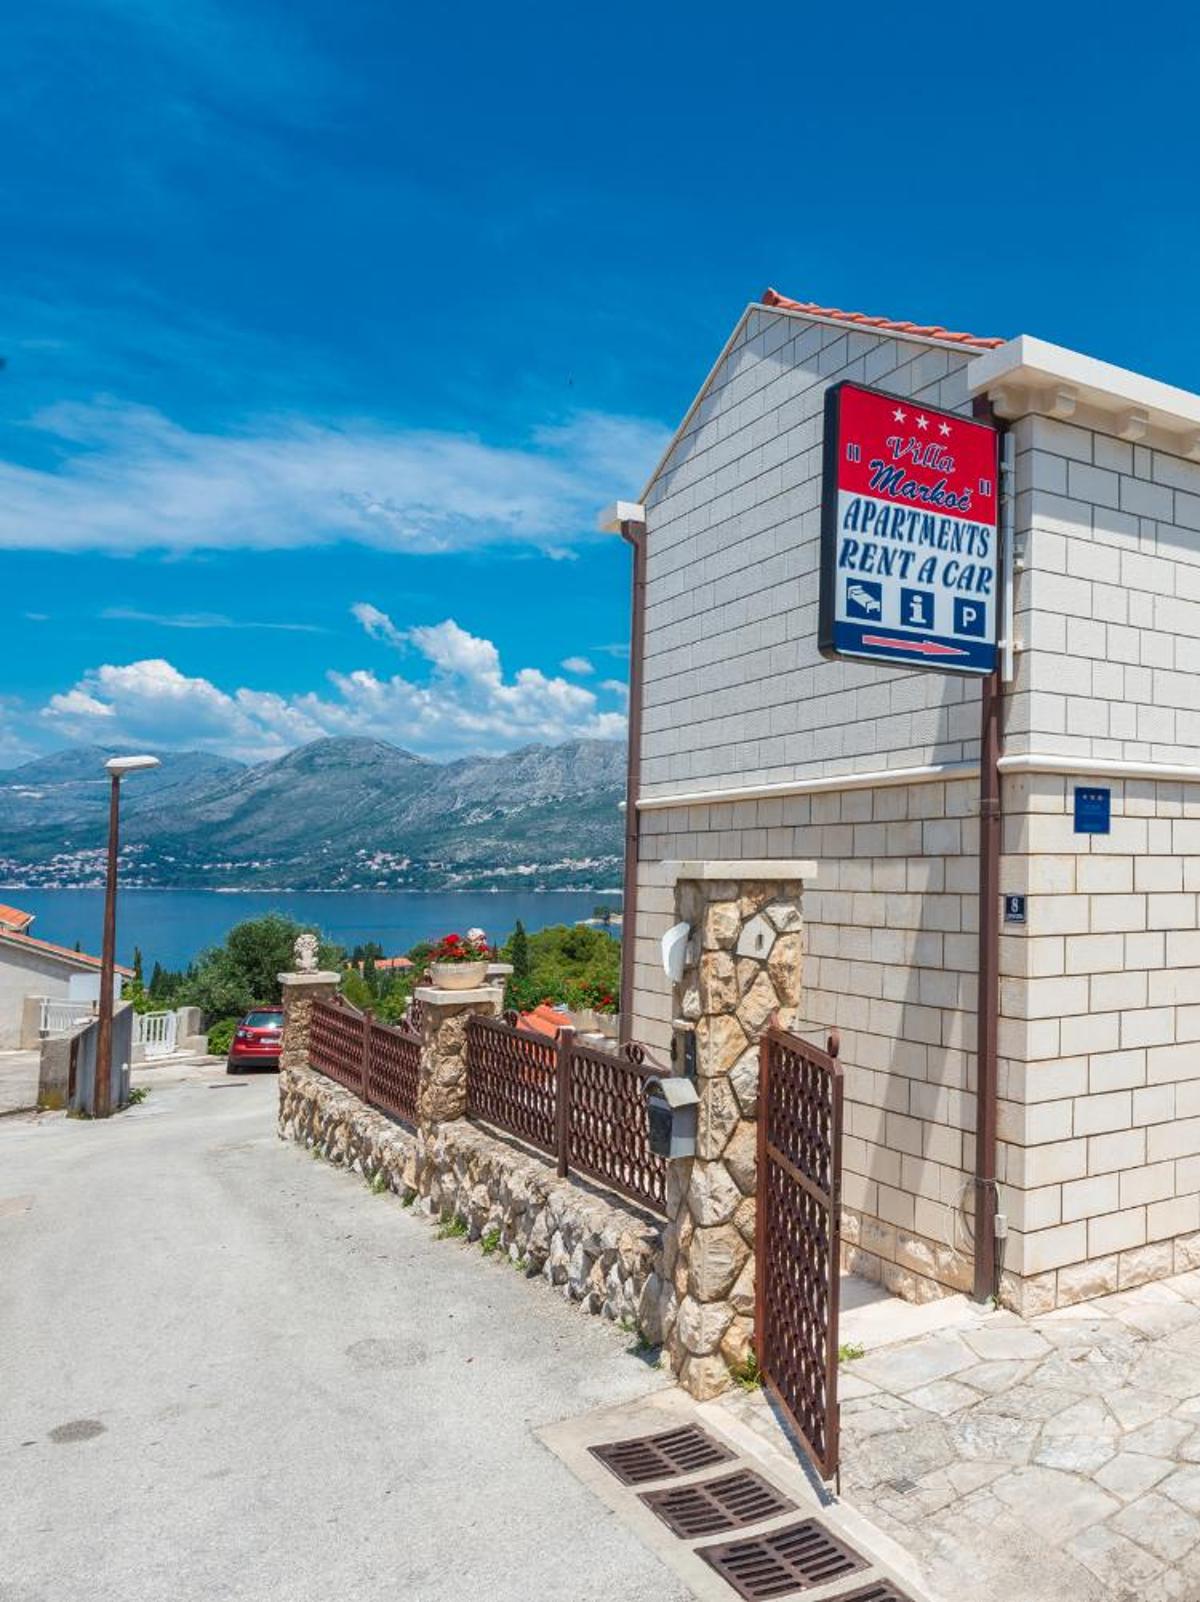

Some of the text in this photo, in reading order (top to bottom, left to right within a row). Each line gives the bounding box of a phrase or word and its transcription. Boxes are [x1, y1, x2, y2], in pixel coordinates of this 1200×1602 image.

[886, 436, 956, 473] Villa
[843, 497, 991, 559] APARTMENTS
[838, 537, 994, 595] RENT A CAR
[962, 606, 977, 627] P
